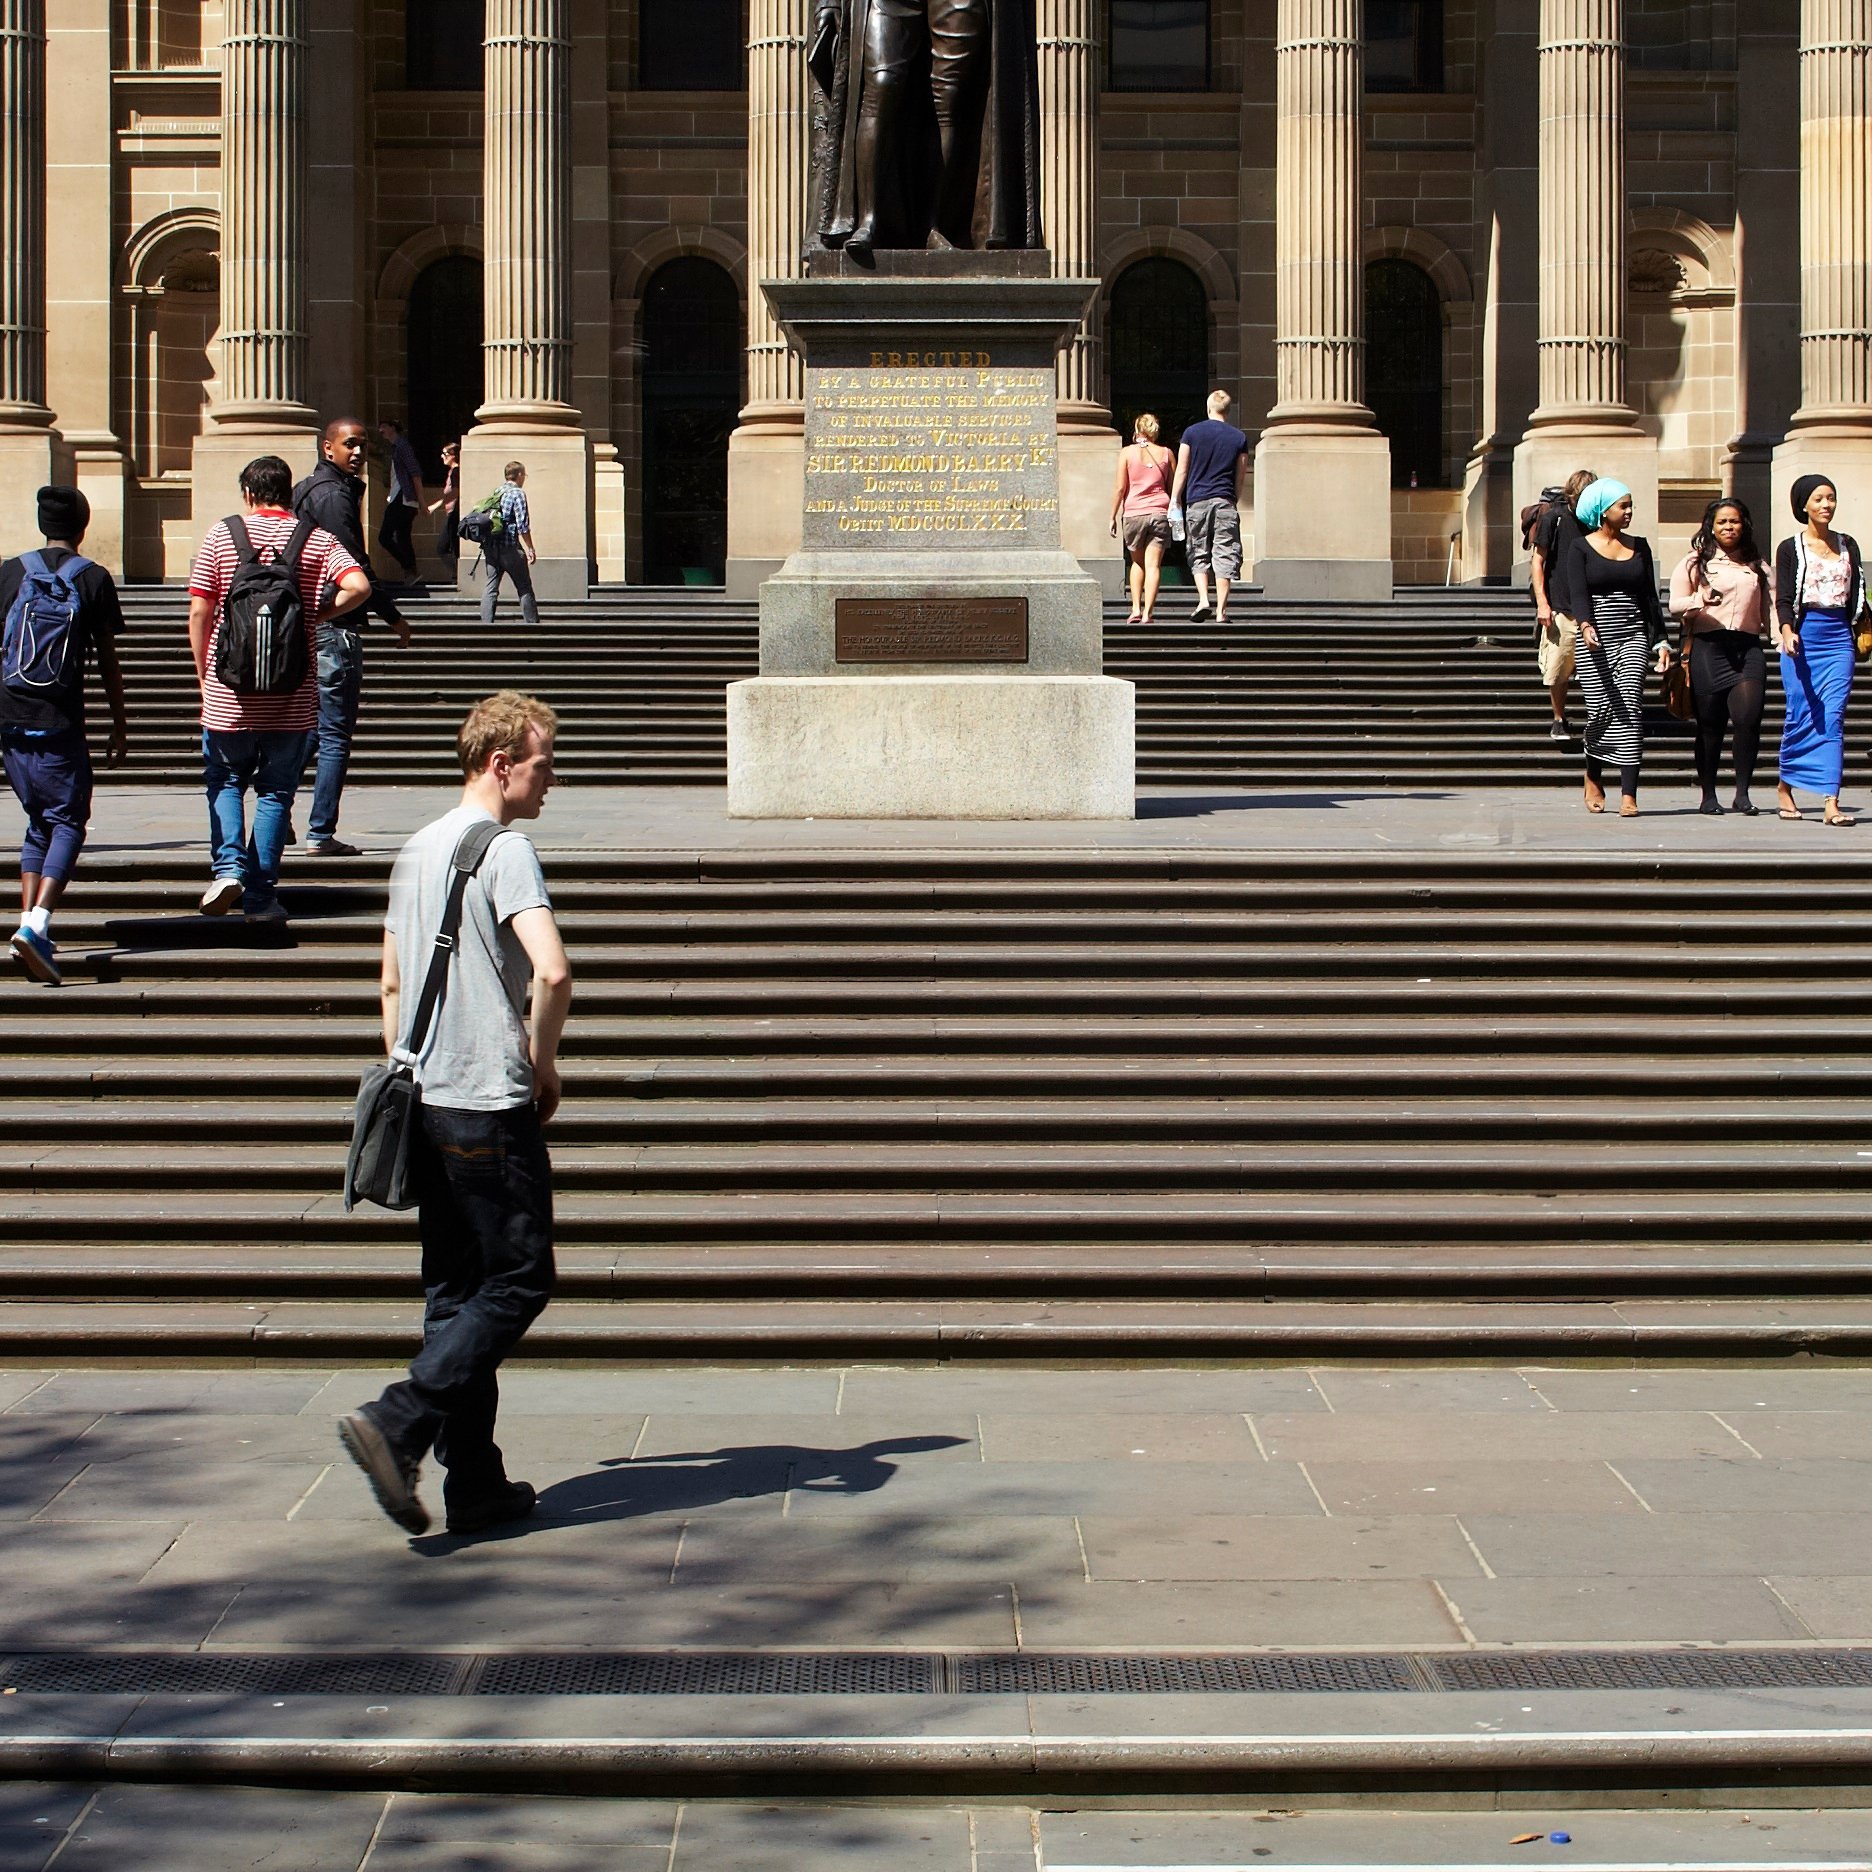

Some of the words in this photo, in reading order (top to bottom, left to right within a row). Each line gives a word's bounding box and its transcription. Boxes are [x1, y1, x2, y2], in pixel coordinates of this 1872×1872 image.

[870, 352, 991, 368] ERECTED
[819, 377, 842, 389] BY
[848, 377, 861, 388] A
[870, 376, 968, 388] GRATEFUL
[976, 372, 1044, 388] PUBLIC
[814, 397, 832, 408] TO
[837, 396, 941, 408] PERPETUATE
[945, 395, 977, 407] THE
[982, 395, 1049, 407] MEMORY
[831, 416, 848, 427] OF
[853, 416, 953, 427] INVALUABLE
[959, 415, 1032, 426] SERVICES
[814, 435, 900, 447] RENDERED
[906, 435, 925, 447] TO
[929, 430, 1022, 446] VICTORIA
[1028, 434, 1049, 446] BY
[806, 456, 847, 474] SIR
[850, 455, 949, 473] REDMOND
[951, 455, 1028, 473] BARRY
[863, 477, 924, 493] DOCTOR
[930, 481, 945, 492] OF
[951, 477, 1000, 492] LAWS
[805, 501, 838, 512] AND
[839, 501, 848, 512] A
[849, 496, 896, 512] JUDGE
[897, 501, 912, 512] OF
[913, 500, 941, 512] THE
[944, 496, 1012, 512] SUPREME
[1013, 495, 1057, 511] COURT
[839, 516, 883, 531] OBIIT
